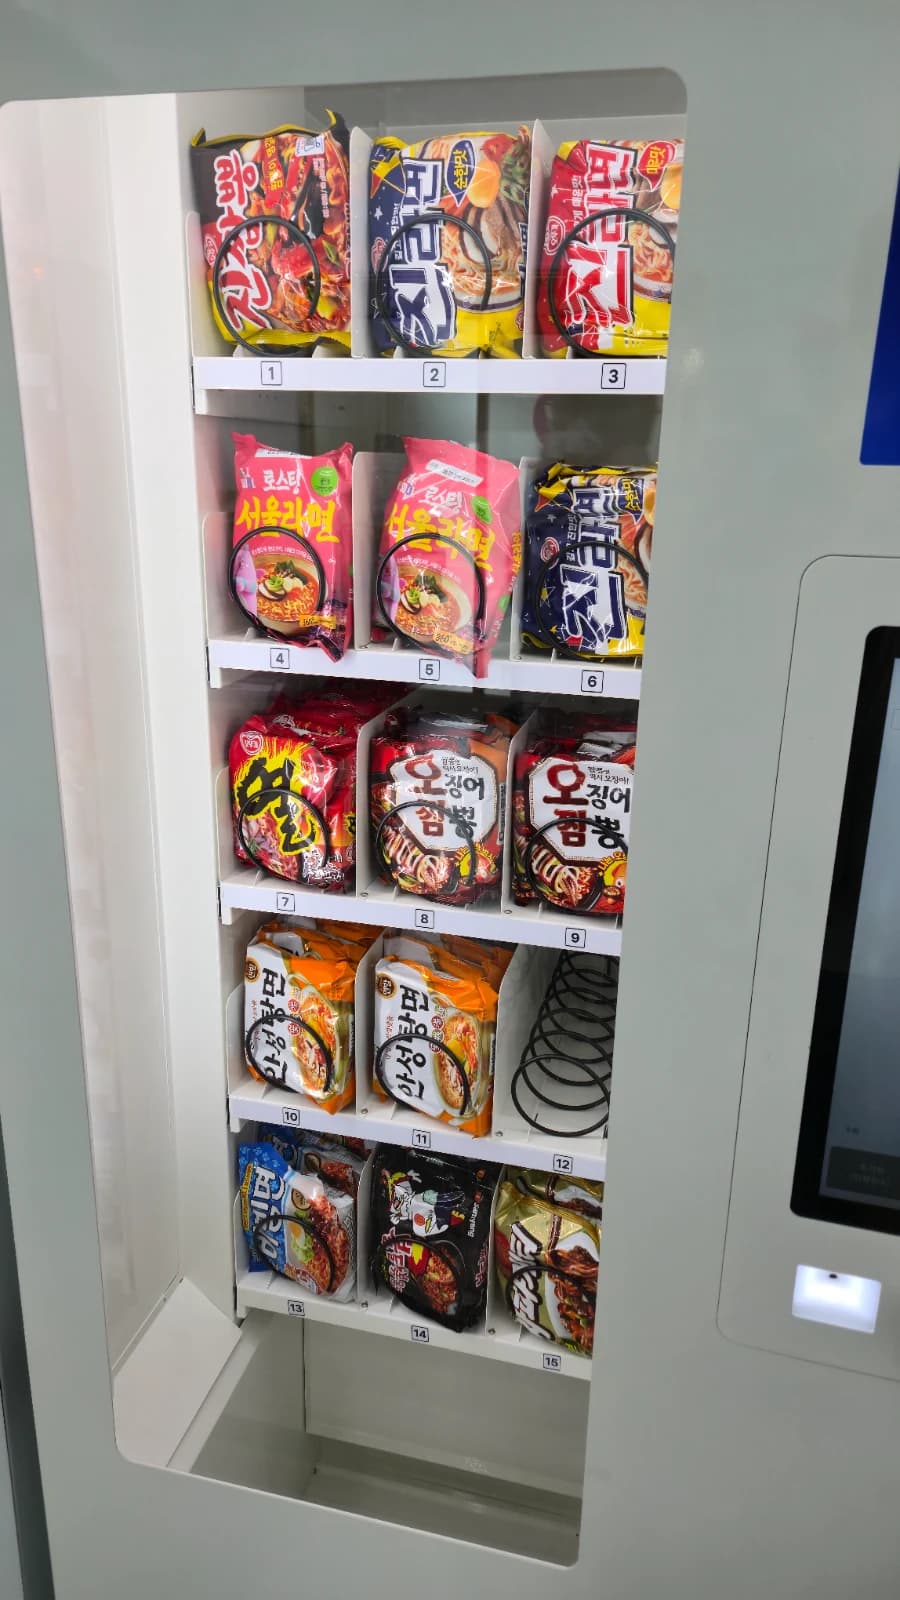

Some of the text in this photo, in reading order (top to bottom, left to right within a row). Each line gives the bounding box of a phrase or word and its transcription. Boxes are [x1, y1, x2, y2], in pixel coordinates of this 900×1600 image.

[453, 149, 468, 190] 순한맛
[646, 146, 665, 174] 매운맛
[213, 149, 273, 331] 진짬뽕
[565, 144, 635, 326] 진라면
[389, 158, 455, 348] 진라면
[267, 367, 274, 379] 1
[430, 368, 438, 381] 2
[608, 370, 617, 382] 3
[623, 478, 640, 511] 순한맛
[237, 495, 340, 543] 서울라면
[385, 504, 496, 573] 서울라면
[559, 487, 626, 642] 진라면
[275, 651, 284, 664] 4
[425, 662, 434, 675] 5
[587, 674, 596, 687] 6
[405, 755, 485, 800] 오징어
[543, 764, 631, 813] 오징어
[236, 757, 316, 853] 열
[415, 799, 477, 837] 짬뽕
[553, 809, 624, 849] 짬뽕
[281, 895, 289, 908] 7
[420, 913, 428, 925] 8
[571, 931, 580, 943] 9
[260, 967, 288, 1084] 안성탕면
[396, 985, 429, 1100] 안성탕면
[284, 1110, 298, 1122] 10
[415, 1133, 426, 1144] 11
[556, 1157, 570, 1169] 12
[467, 1201, 480, 1237] samyang
[289, 1302, 303, 1313] 13
[413, 1328, 427, 1340] 14
[545, 1356, 558, 1367] 15
